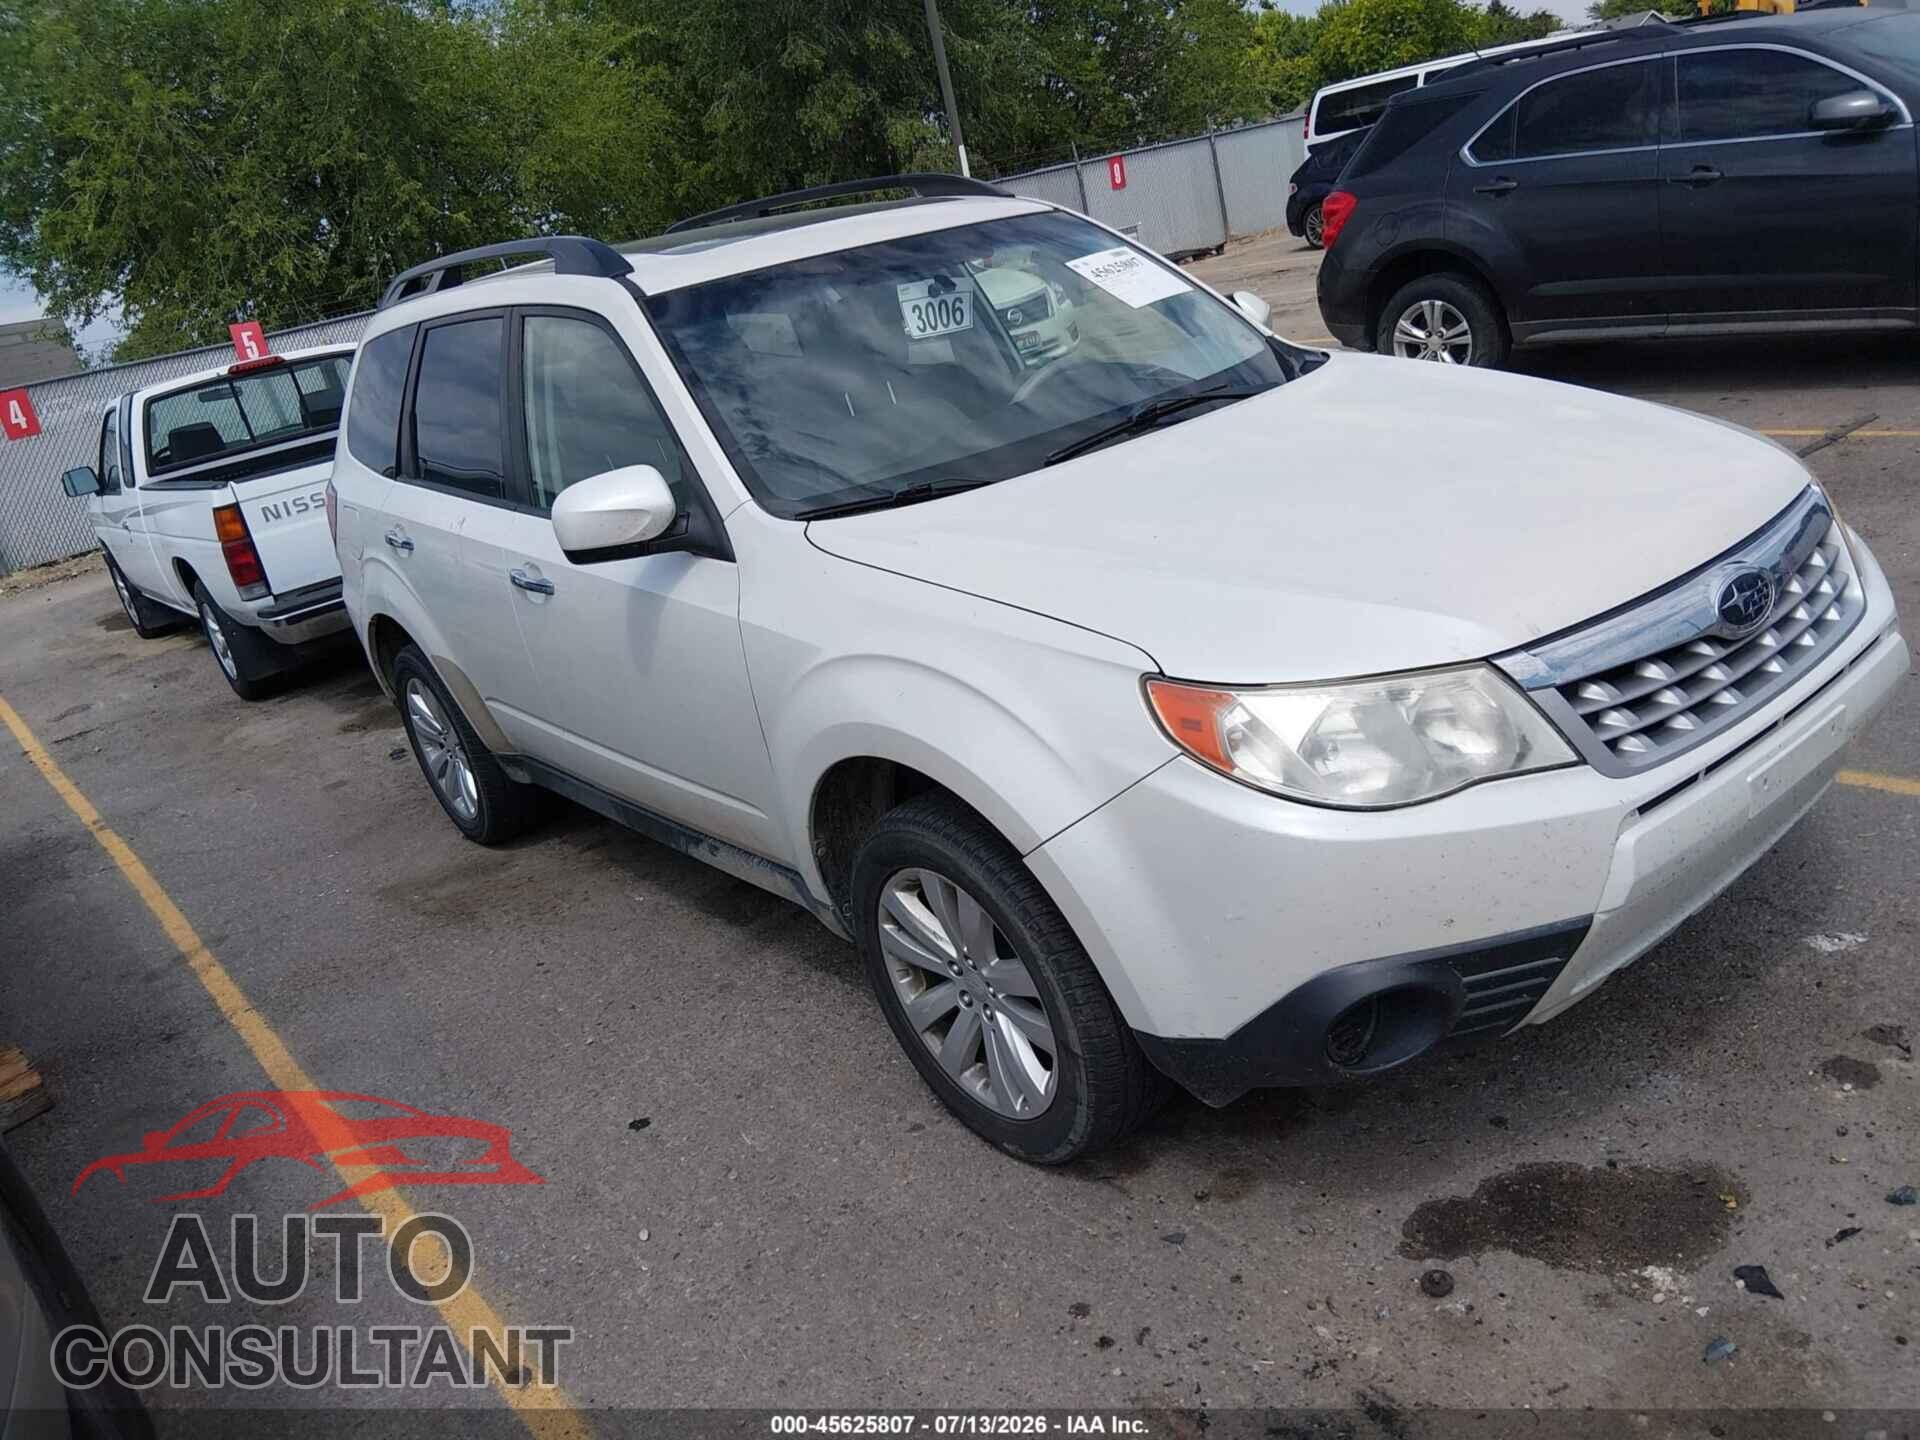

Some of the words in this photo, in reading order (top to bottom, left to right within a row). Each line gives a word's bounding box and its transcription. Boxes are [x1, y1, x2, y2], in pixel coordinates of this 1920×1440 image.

[911, 297, 964, 333] 3006
[240, 331, 259, 361] 5
[8, 399, 28, 429] 4
[261, 492, 326, 523] NISS
